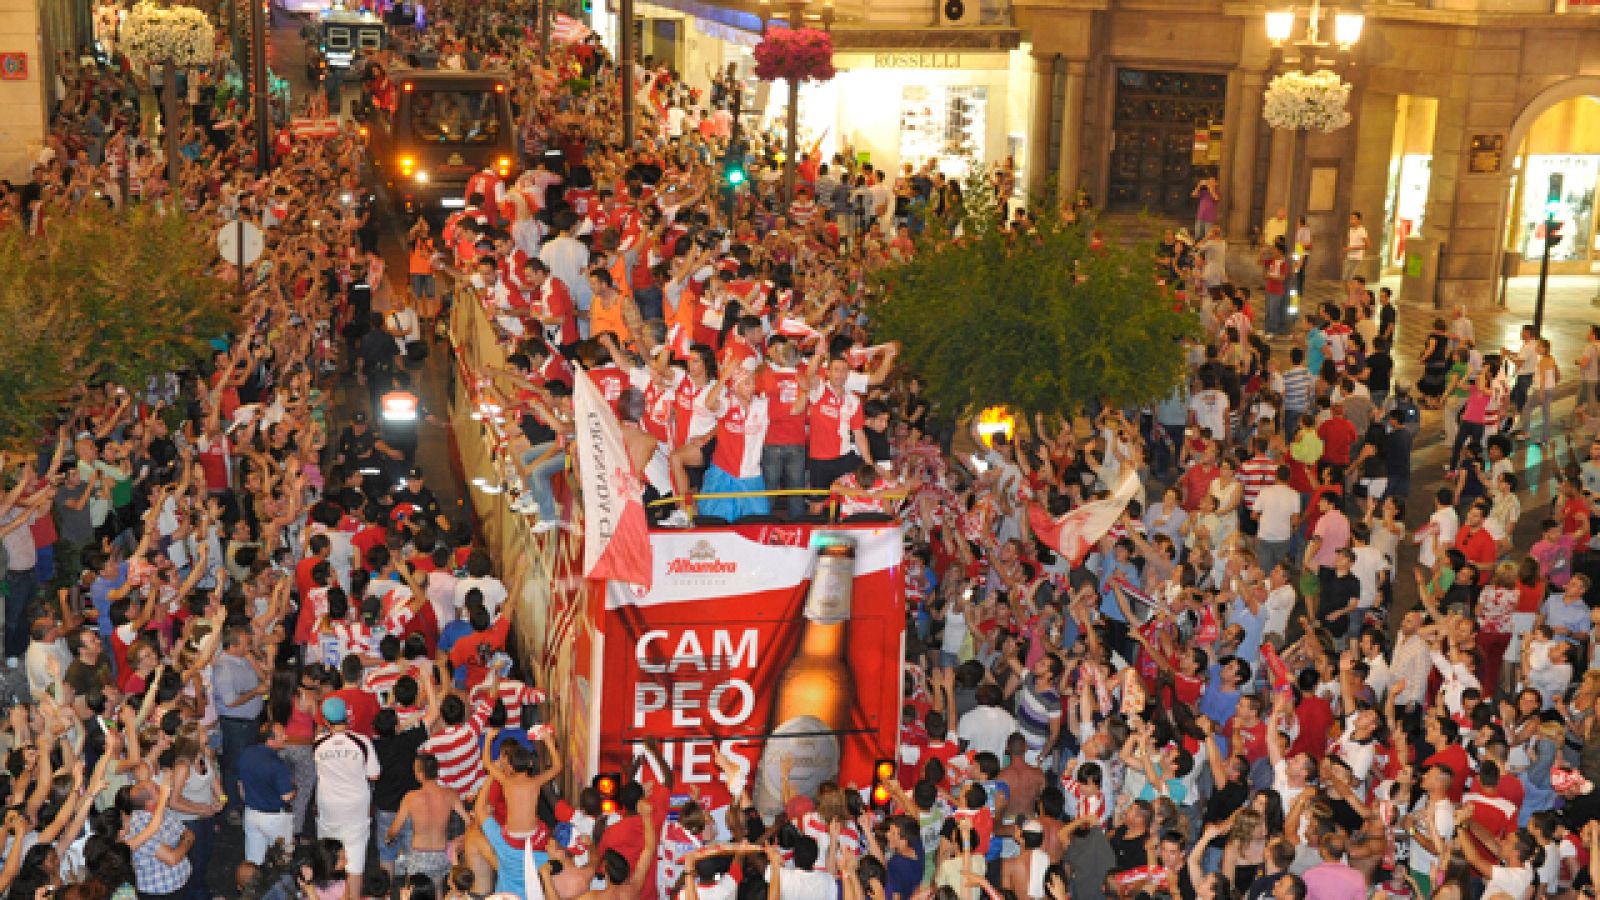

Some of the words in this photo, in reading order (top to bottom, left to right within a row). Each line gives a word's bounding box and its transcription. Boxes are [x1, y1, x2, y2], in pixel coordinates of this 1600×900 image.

[874, 53, 961, 68] ROSSELLI
[666, 557, 737, 575] Alhambra
[635, 629, 759, 673] CAM
[634, 679, 756, 728] PEO
[632, 738, 751, 784] NES
